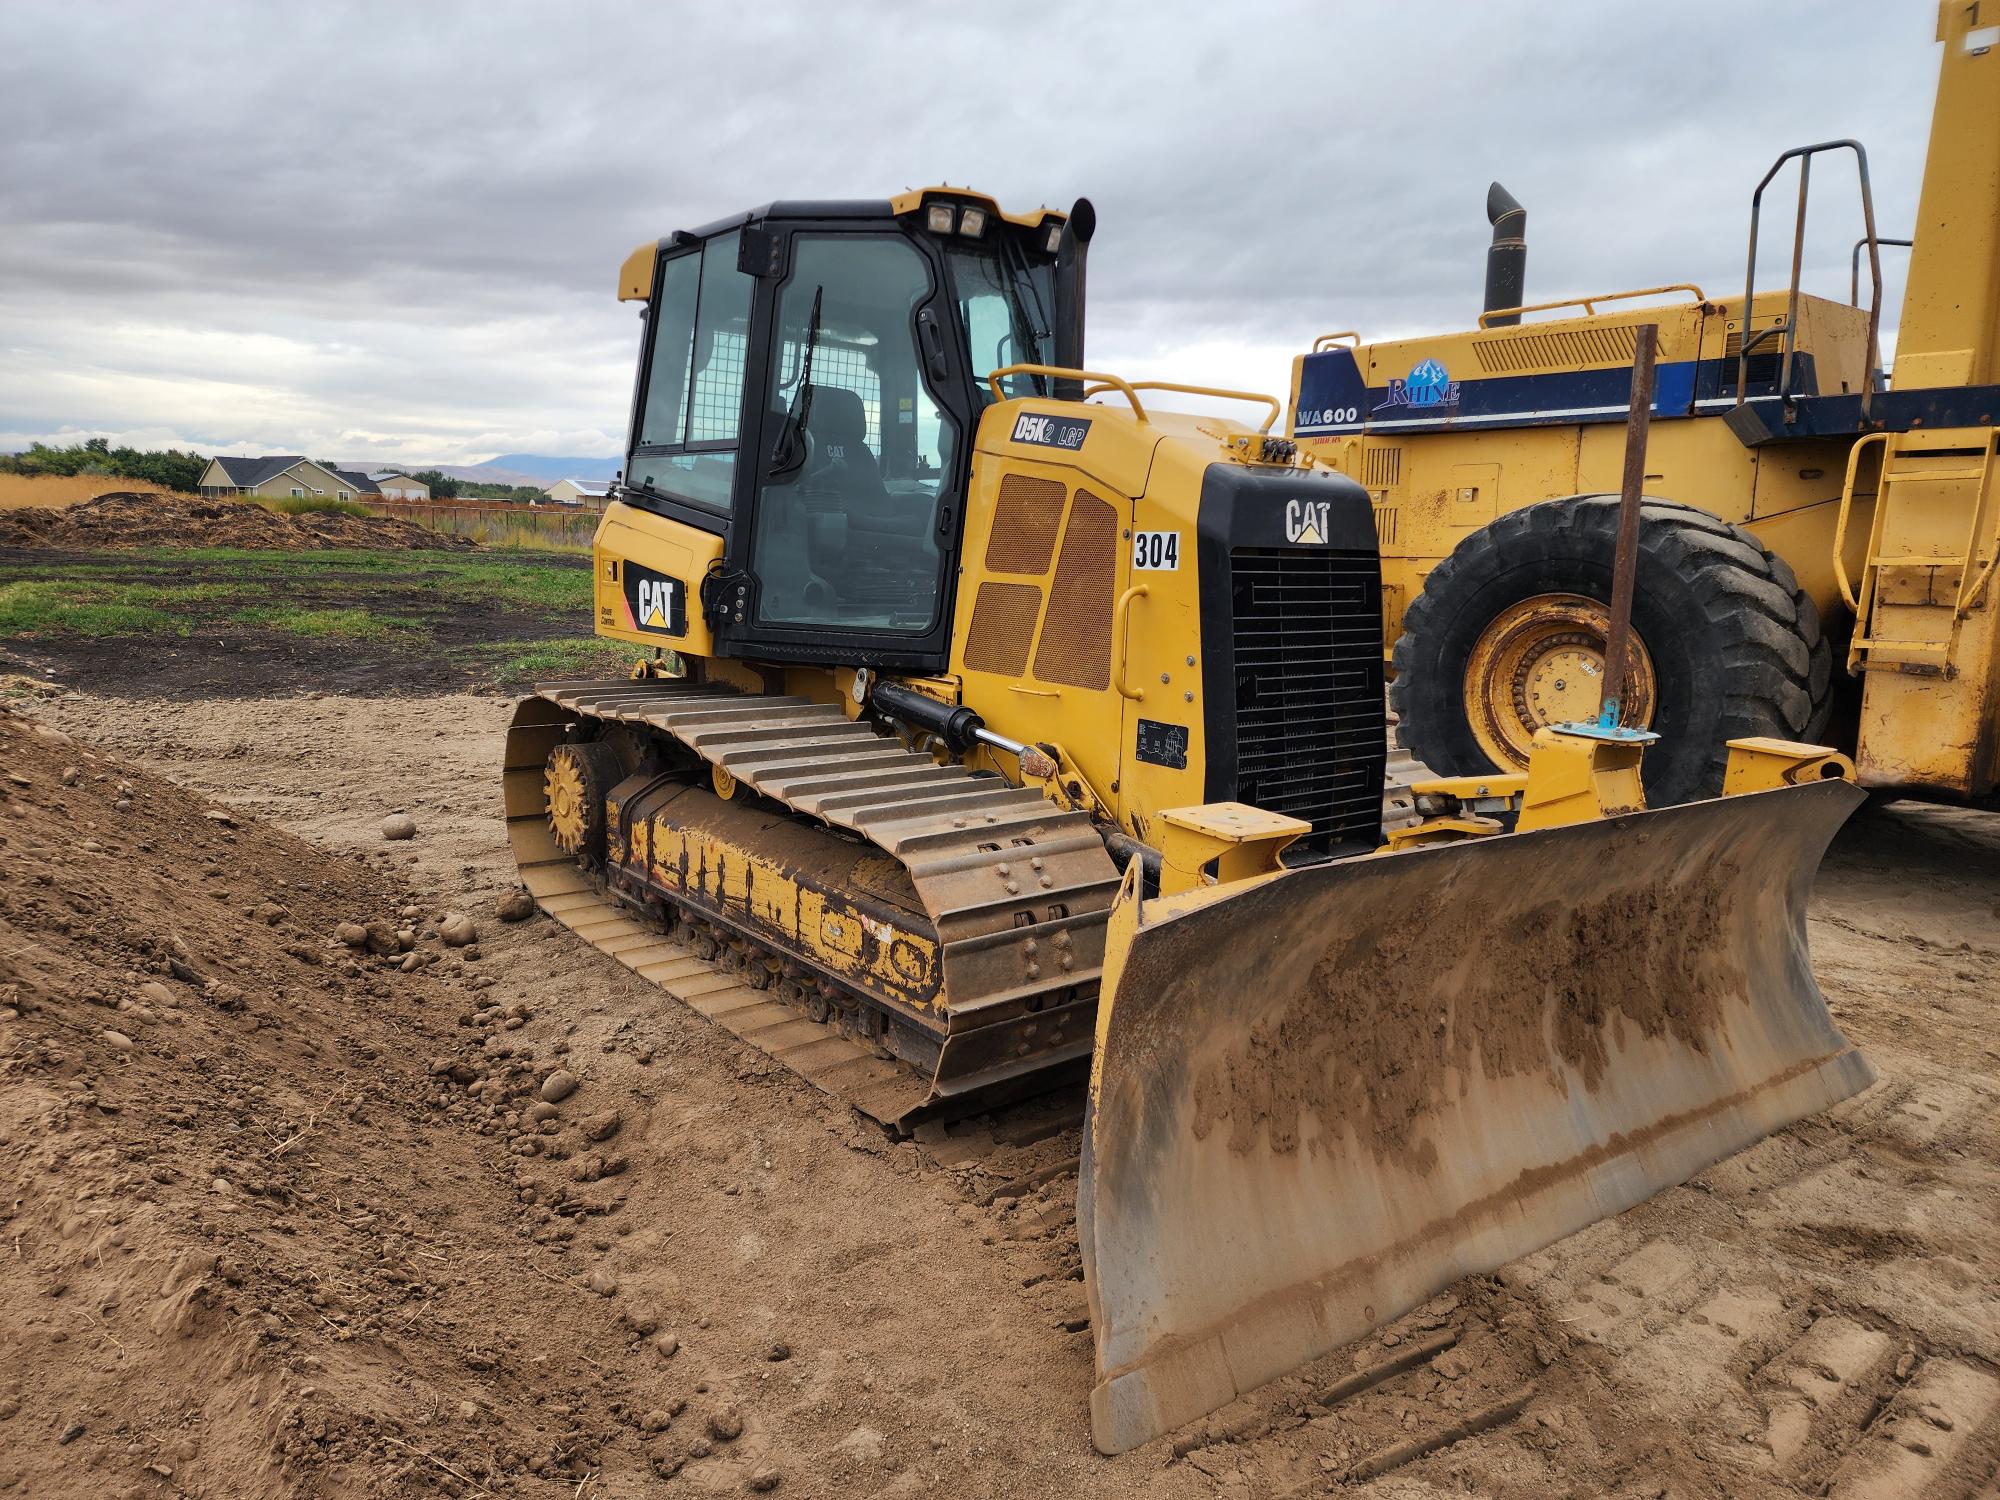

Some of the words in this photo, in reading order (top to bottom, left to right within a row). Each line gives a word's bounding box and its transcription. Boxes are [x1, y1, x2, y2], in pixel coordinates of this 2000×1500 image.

[1376, 379, 1460, 408] RHINE
[1298, 407, 1358, 425] WA600
[1058, 426, 1085, 446] LGP
[827, 445, 845, 457] CAT
[1286, 500, 1331, 544] CAT
[1135, 534, 1177, 568] 304
[638, 579, 673, 629] CAT
